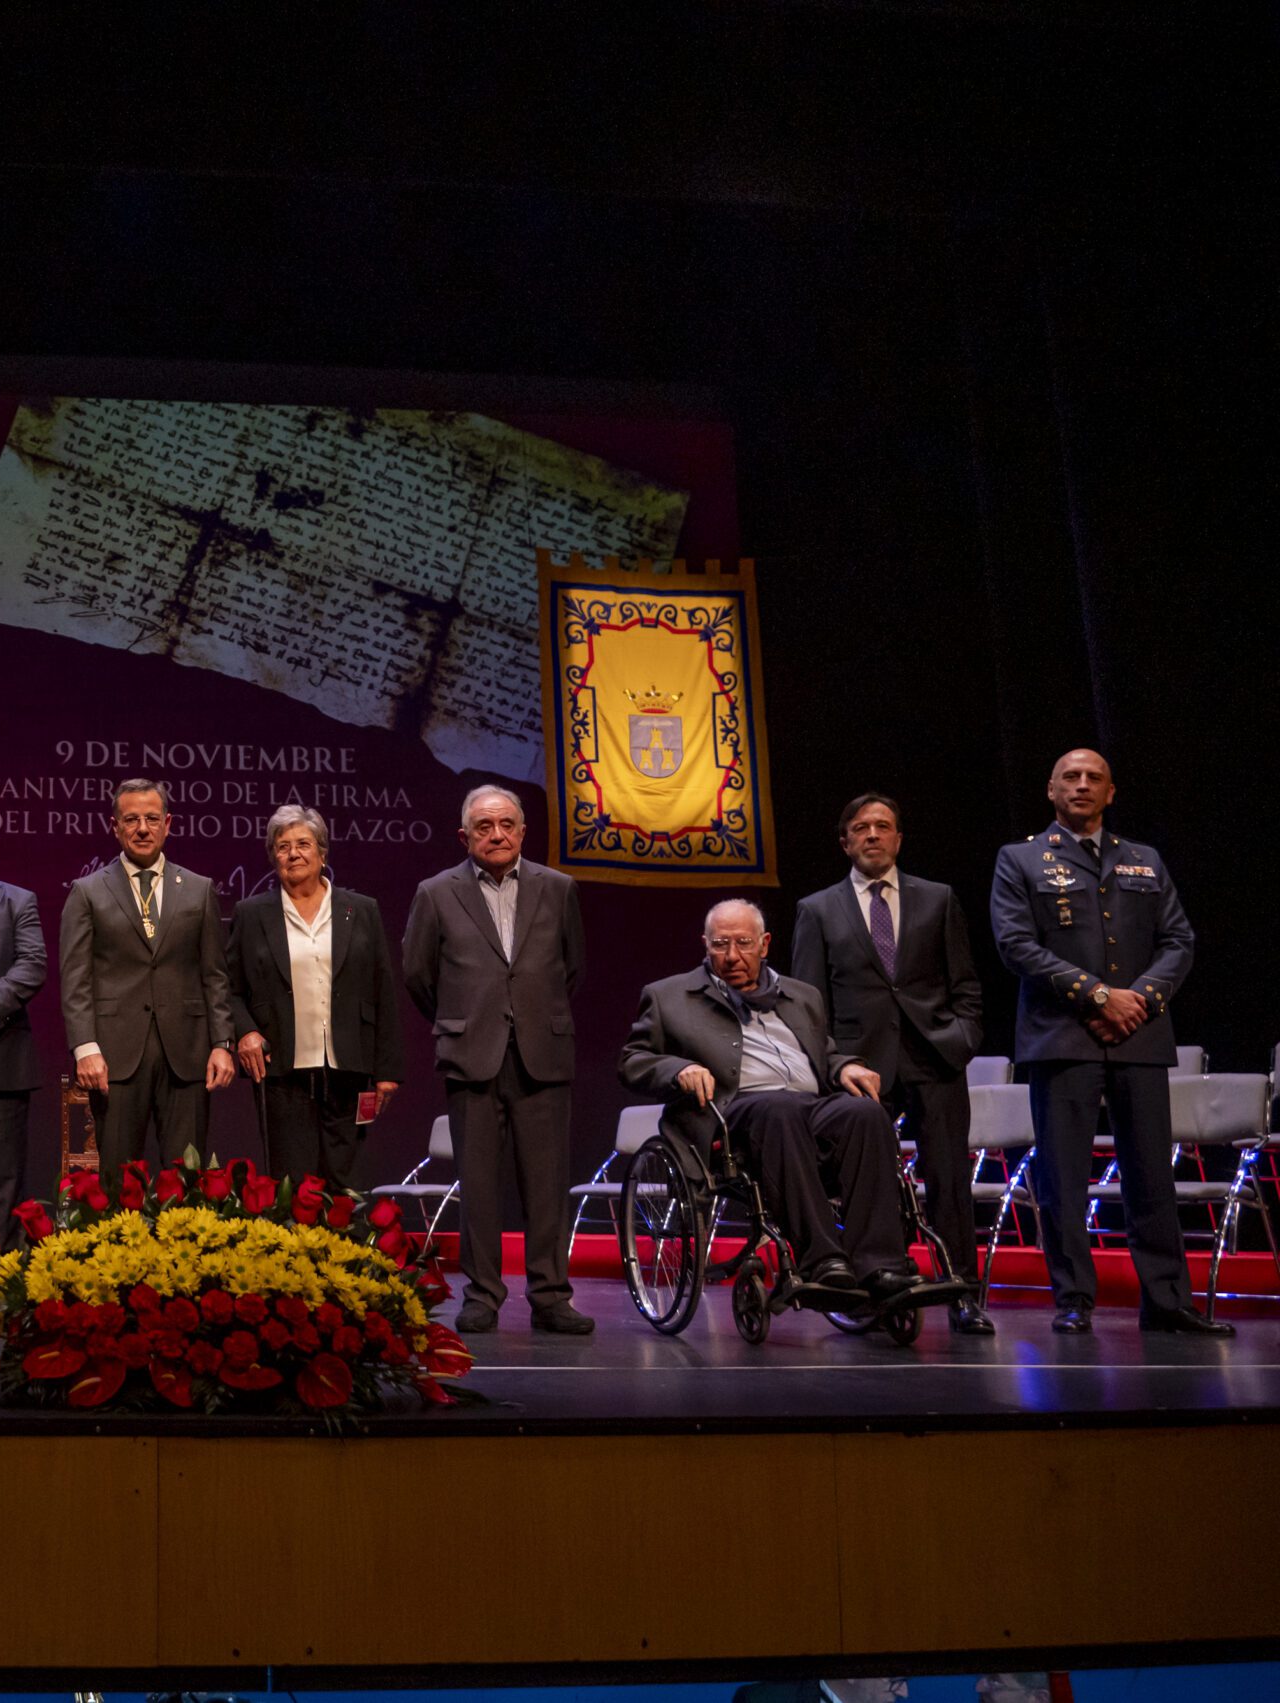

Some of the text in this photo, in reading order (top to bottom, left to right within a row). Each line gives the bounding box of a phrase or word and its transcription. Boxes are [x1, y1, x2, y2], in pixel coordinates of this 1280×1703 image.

[55, 740, 357, 774] 9 DE NOVIEMBRE
[0, 777, 413, 809] ANIVERRIO DE LA FIRMA
[47, 811, 221, 838] PRIVGIO
